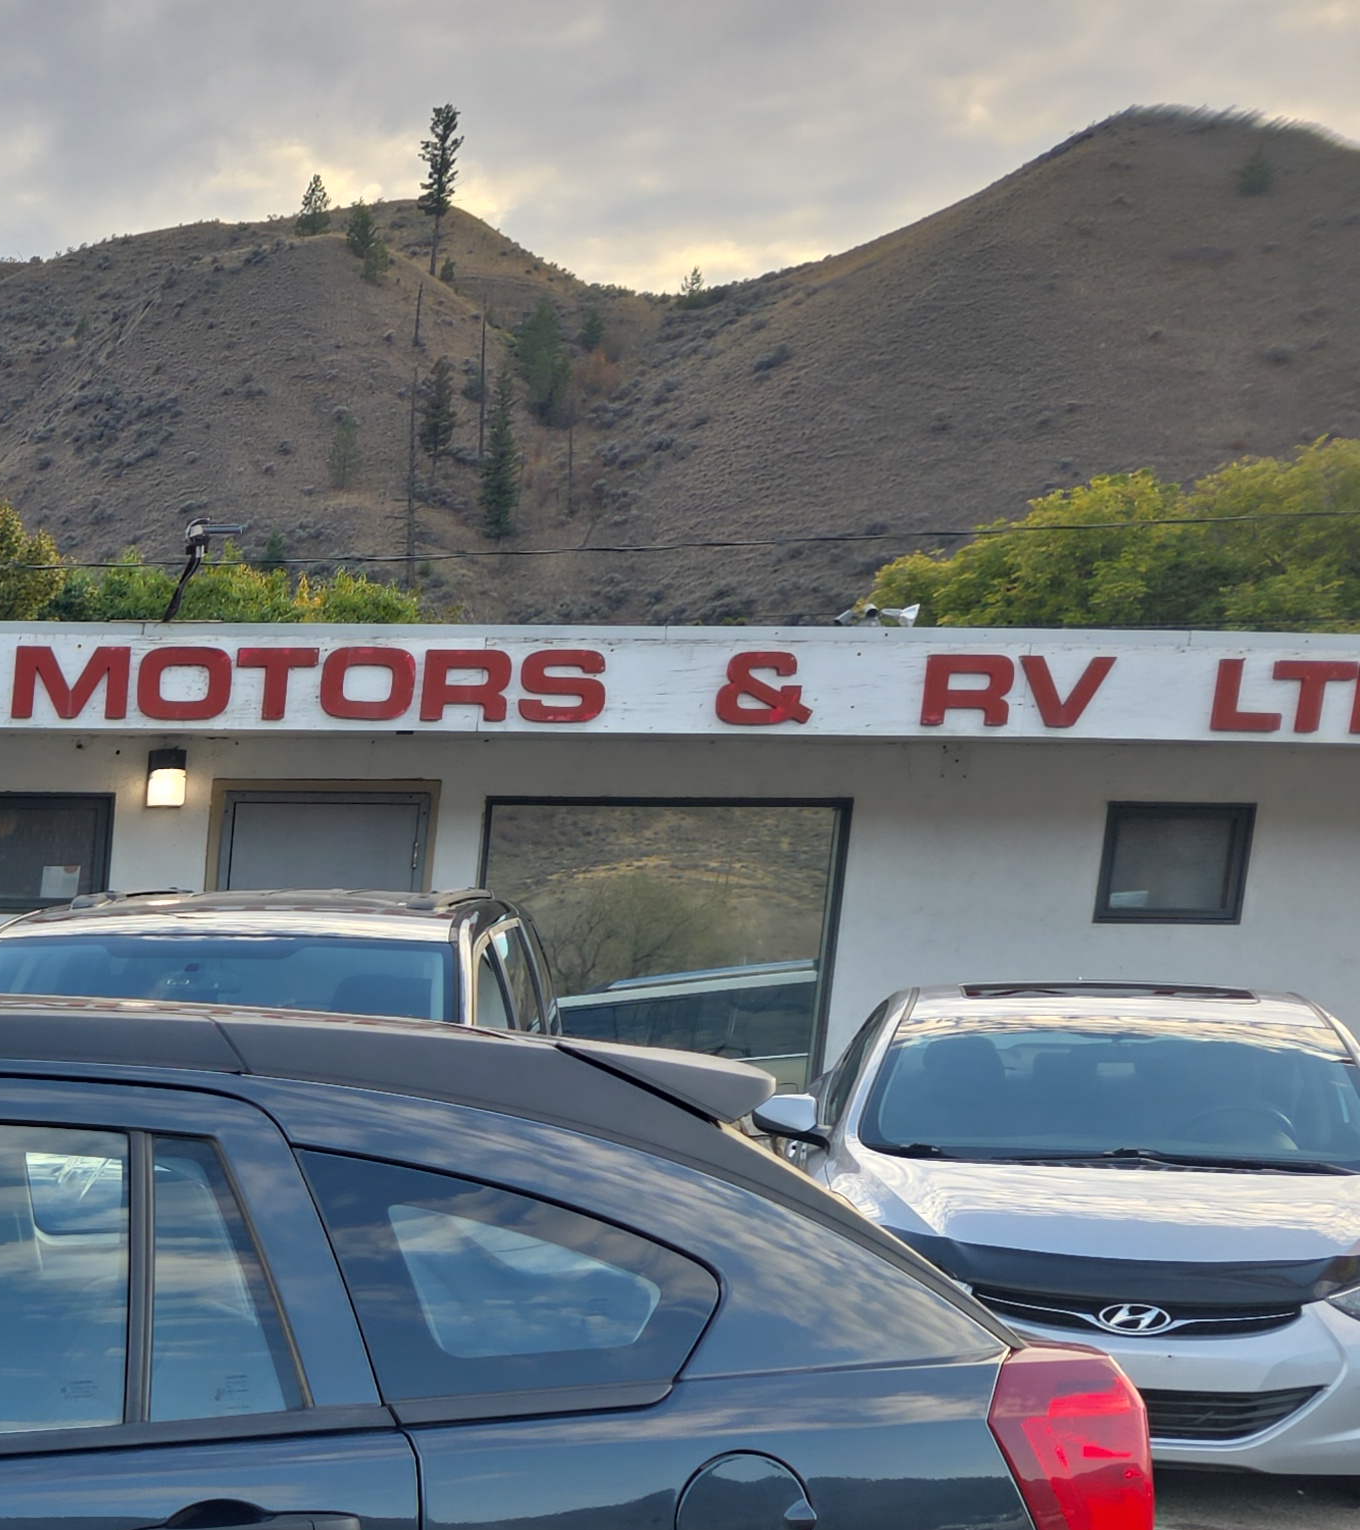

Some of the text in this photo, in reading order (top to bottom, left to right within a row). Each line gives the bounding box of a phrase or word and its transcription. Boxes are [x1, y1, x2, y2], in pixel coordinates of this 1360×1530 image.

[9, 644, 609, 724] MOTORS
[715, 650, 813, 726] &
[919, 652, 1117, 729] RV
[1209, 657, 1360, 735] LT
